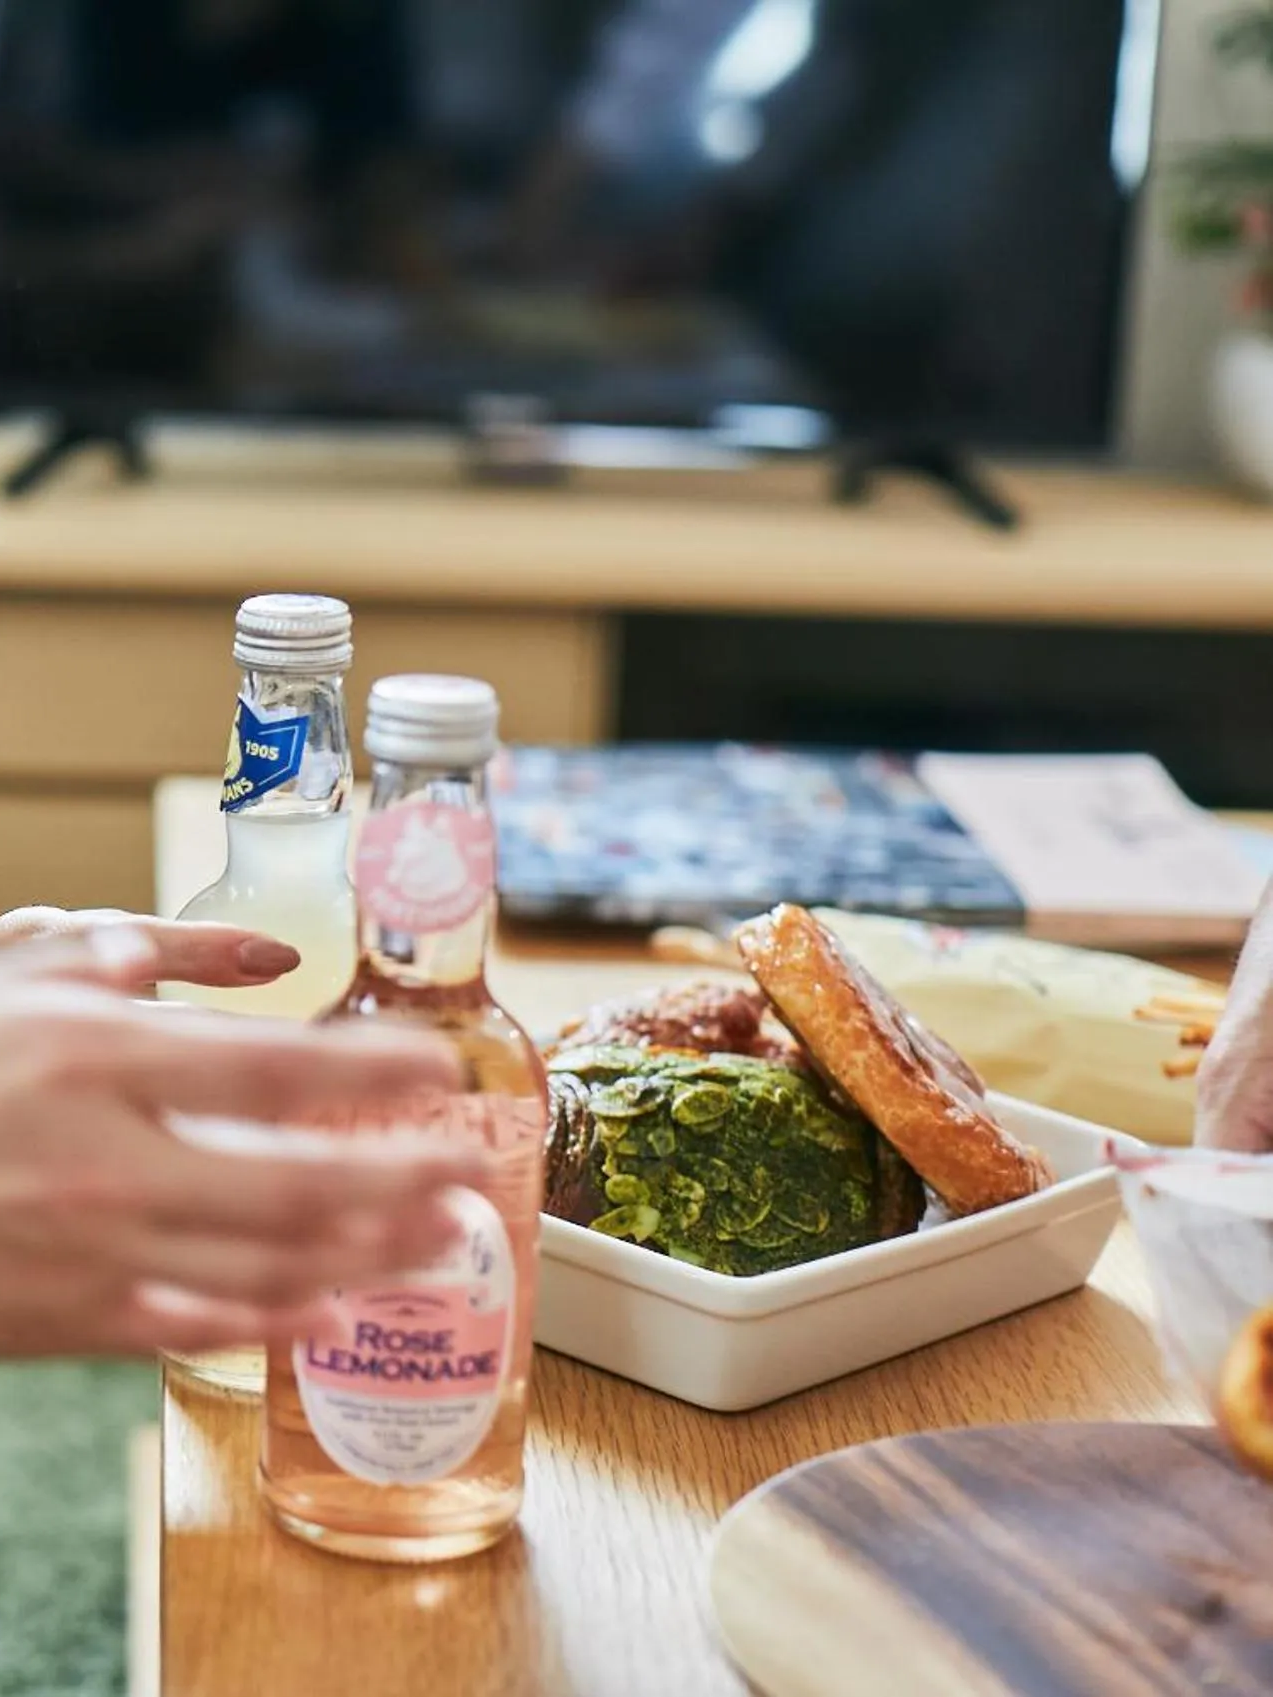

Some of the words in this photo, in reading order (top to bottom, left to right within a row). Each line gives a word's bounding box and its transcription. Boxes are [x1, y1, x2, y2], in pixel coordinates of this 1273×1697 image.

[245, 740, 280, 761] 1905
[356, 1320, 456, 1353] ROSE
[307, 1336, 498, 1381] LEMONADE
